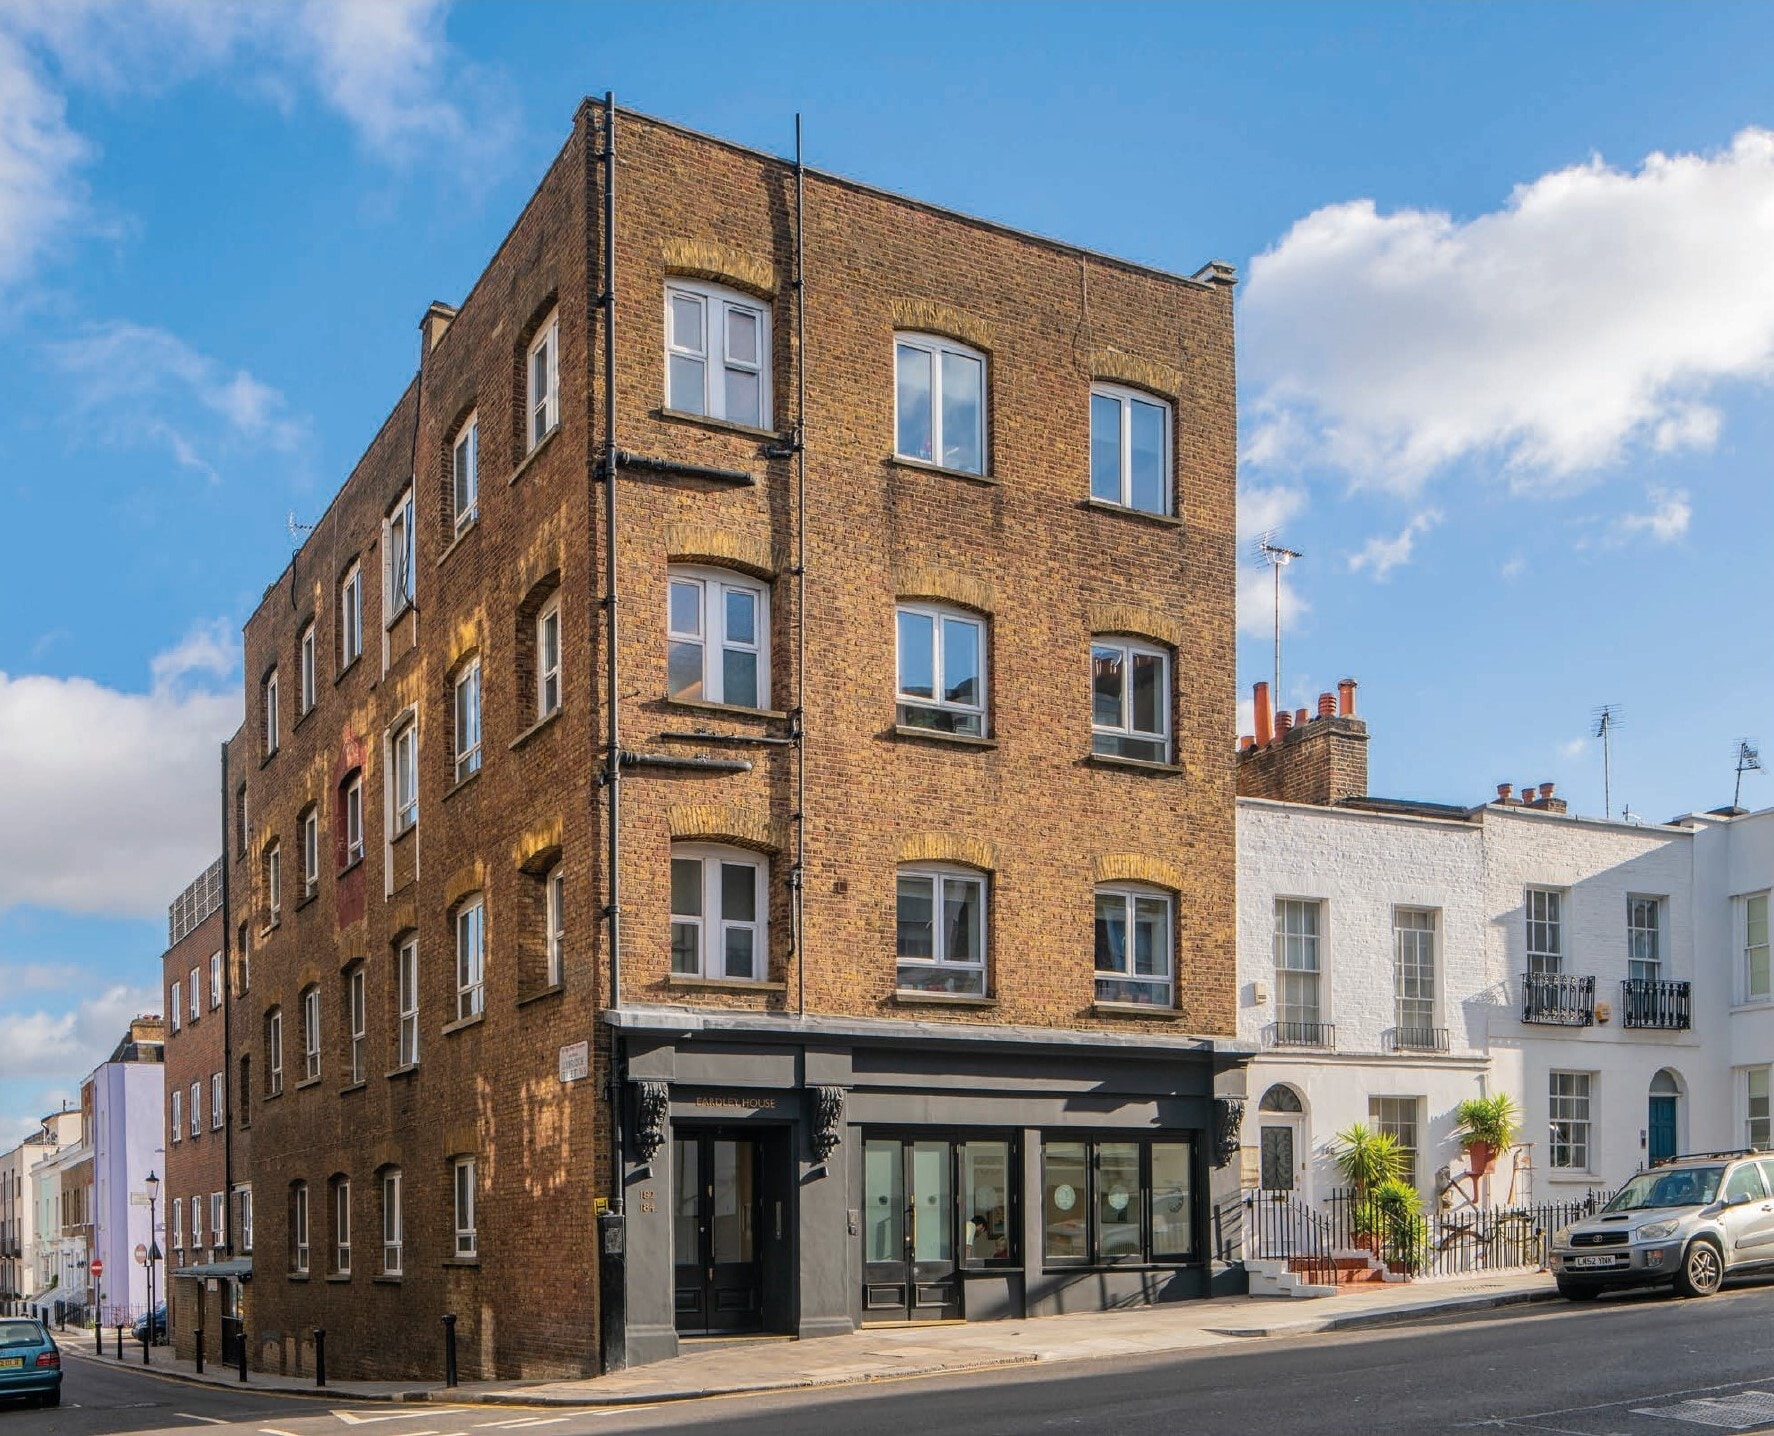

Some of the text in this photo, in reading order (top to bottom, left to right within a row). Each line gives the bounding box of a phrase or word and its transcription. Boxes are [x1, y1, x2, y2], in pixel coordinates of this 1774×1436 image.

[696, 1098, 776, 1108] EARDLEY HOUSE
[640, 1190, 656, 1199] 182
[640, 1203, 656, 1212] 184
